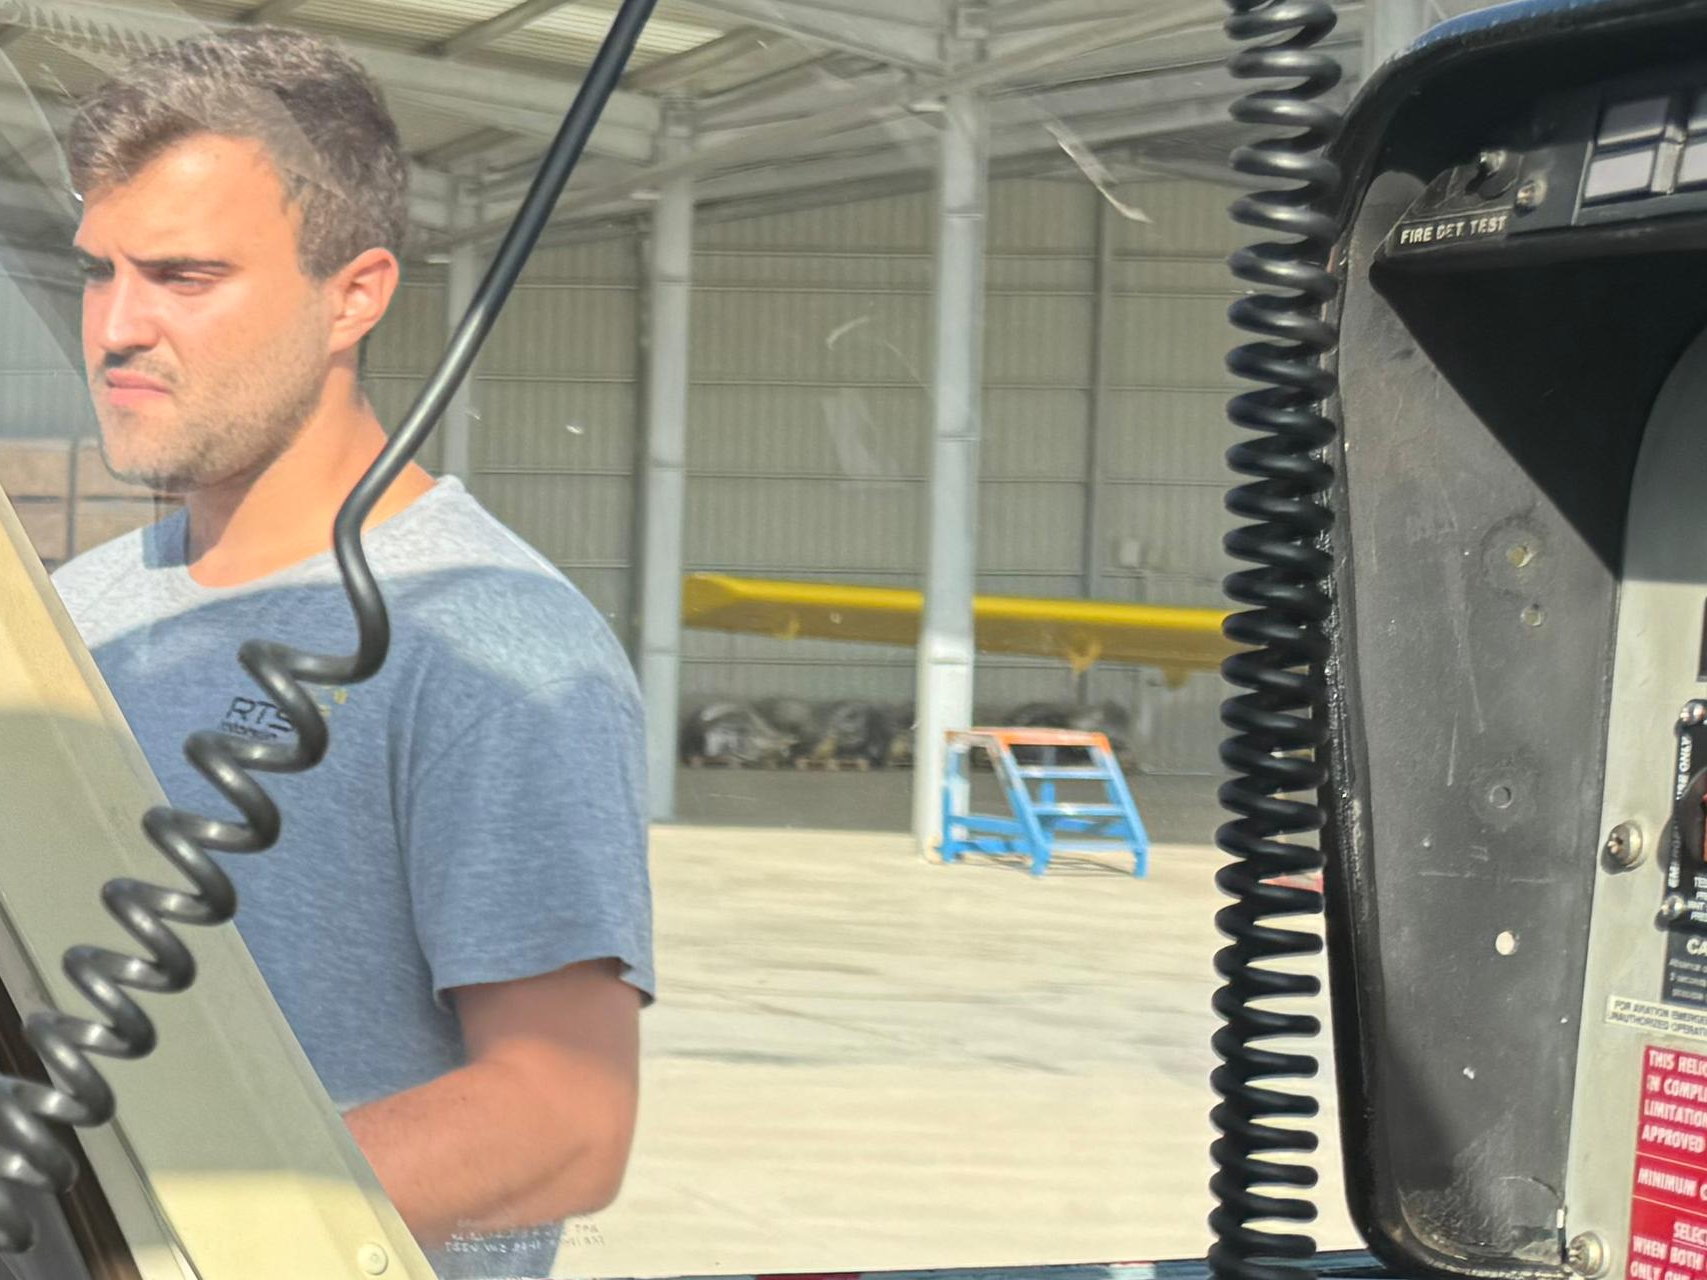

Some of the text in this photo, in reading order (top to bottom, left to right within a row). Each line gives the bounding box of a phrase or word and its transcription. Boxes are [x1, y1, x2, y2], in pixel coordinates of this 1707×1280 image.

[1400, 226, 1434, 245] FIRE
[1470, 215, 1507, 236] TEST
[226, 697, 294, 733] RTS
[1648, 1049, 1676, 1071] THIS
[1646, 1074, 1662, 1093] IN
[1641, 1124, 1706, 1154] APPROVED
[1637, 1167, 1697, 1198] MINIMUM
[1633, 1235, 1704, 1271] WHEN BOTH
